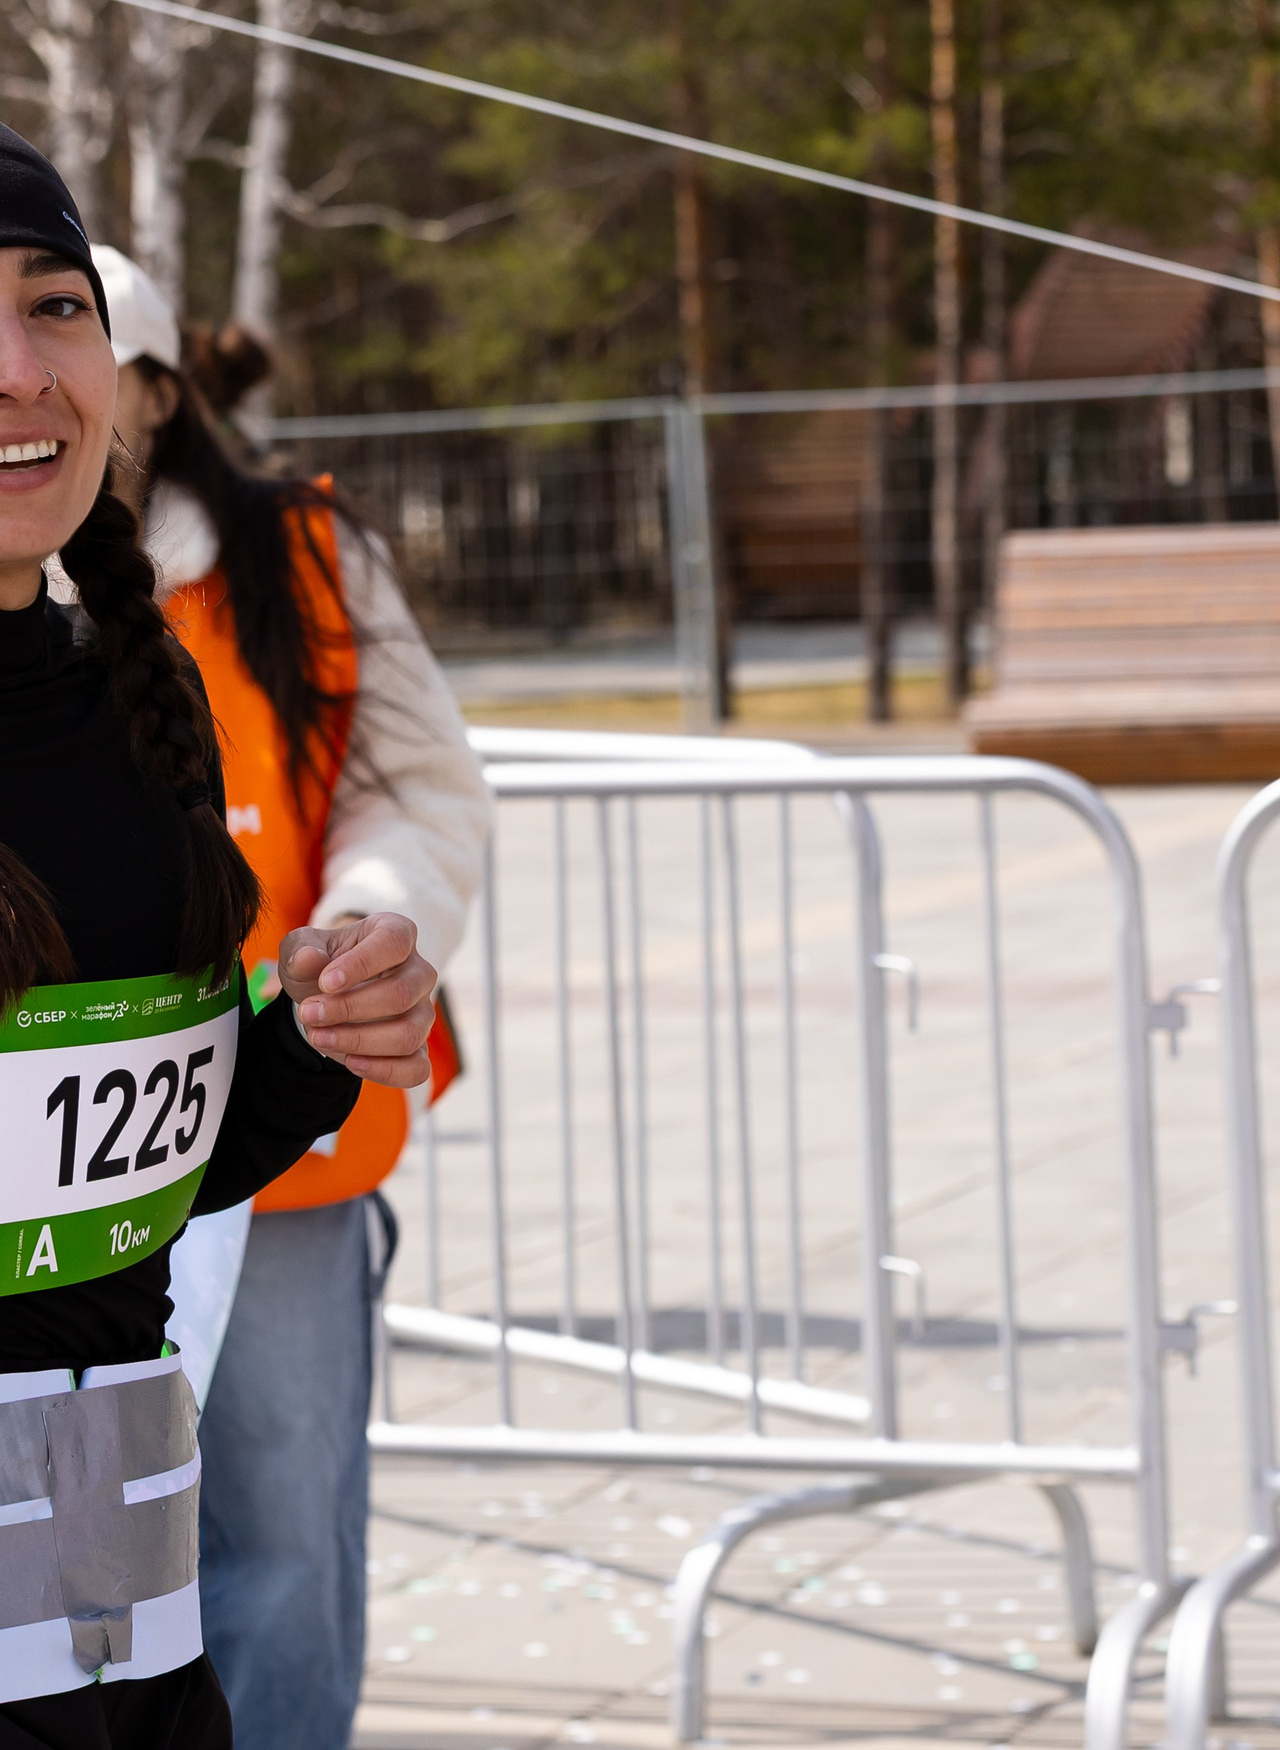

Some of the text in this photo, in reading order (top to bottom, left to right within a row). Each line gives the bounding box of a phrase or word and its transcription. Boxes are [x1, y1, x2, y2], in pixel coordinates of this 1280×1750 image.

[85, 1002, 115, 1012] зелёный
[155, 993, 183, 1007] ЦЕНТР
[34, 1010, 67, 1024] СБЕР
[81, 1010, 113, 1021] марафон
[46, 1044, 215, 1188] 1225
